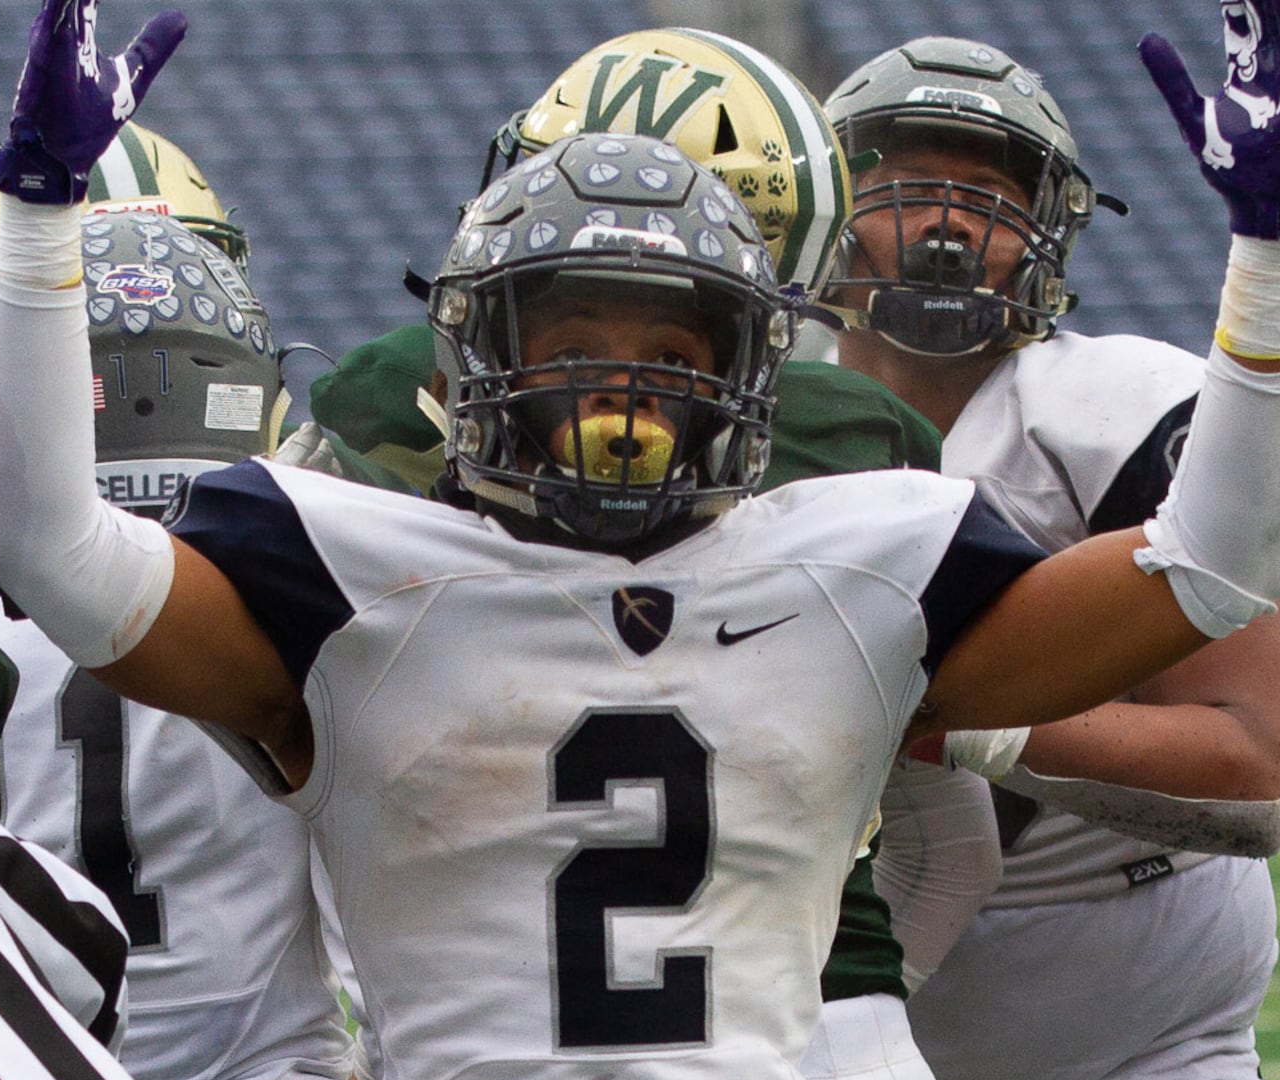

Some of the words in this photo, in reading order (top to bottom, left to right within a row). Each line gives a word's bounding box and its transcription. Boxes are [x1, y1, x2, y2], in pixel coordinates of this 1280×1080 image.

[578, 53, 726, 138] W
[102, 276, 170, 290] GHSA
[546, 705, 718, 1055] 2
[1130, 860, 1169, 882] 2XL
